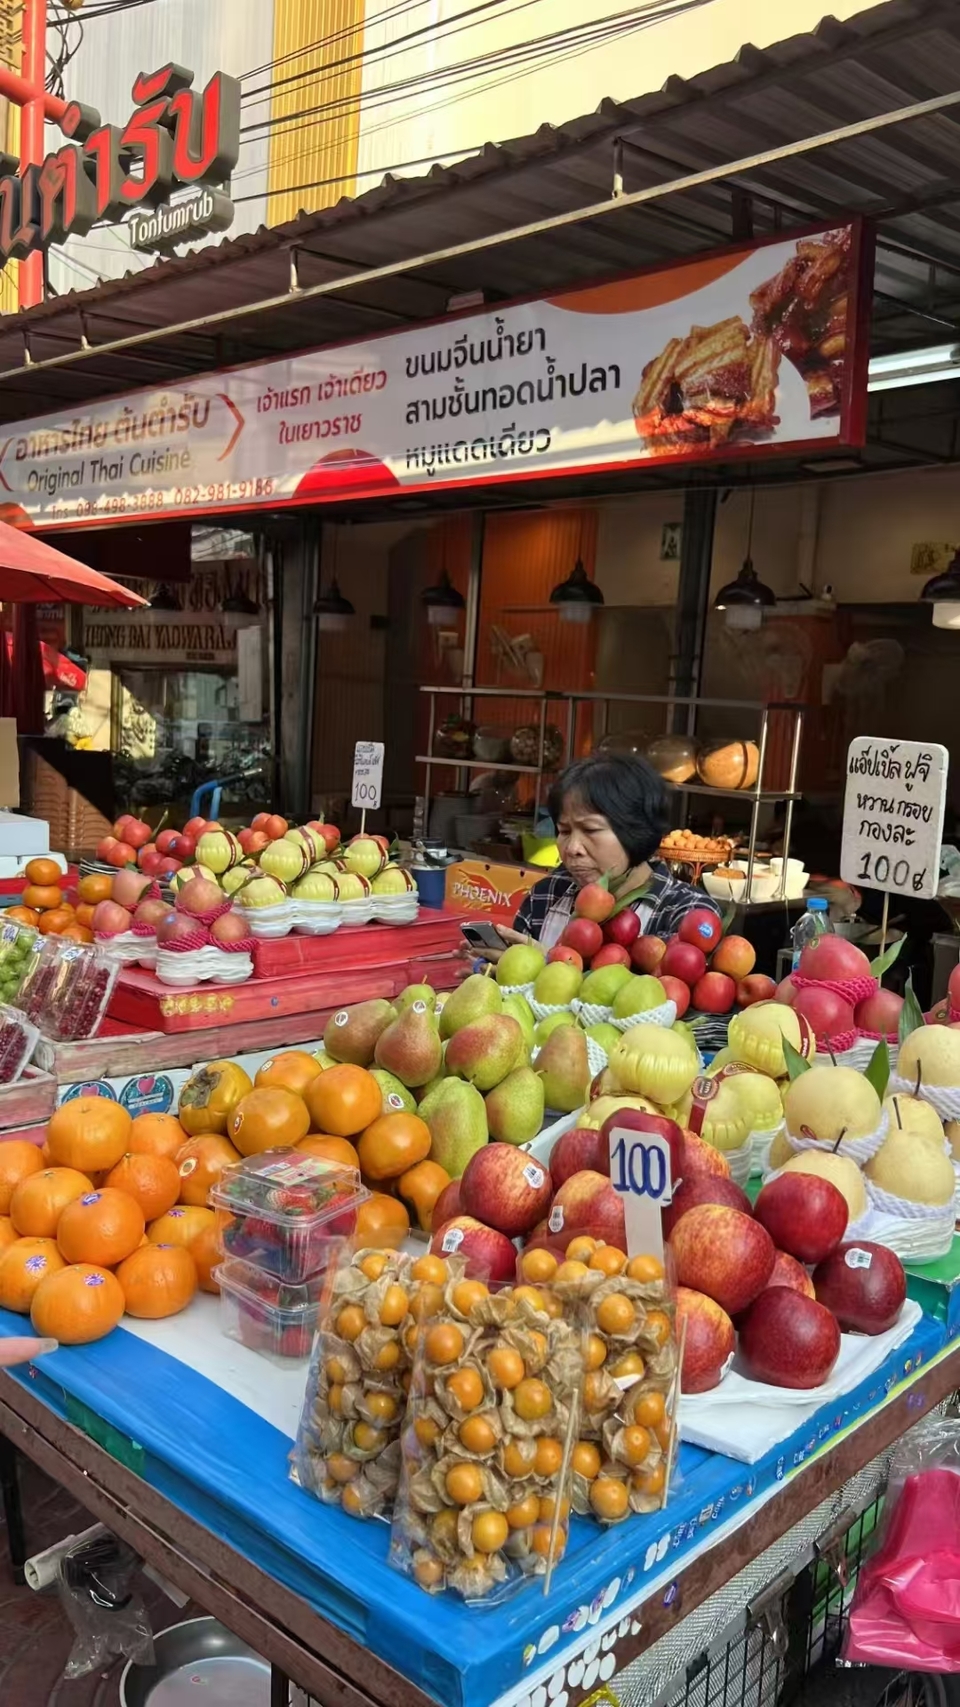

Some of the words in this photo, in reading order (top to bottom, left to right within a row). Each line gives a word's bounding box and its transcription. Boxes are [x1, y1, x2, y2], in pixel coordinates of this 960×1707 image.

[130, 191, 214, 244] Tontumrub
[405, 317, 547, 379] ขนมจีนน้ำยา
[257, 387, 311, 413] เจ้าแรก
[318, 366, 388, 401] เจ้าเดียว
[405, 356, 622, 424] สามชั้นทอดน้ำปลา
[15, 419, 109, 461] อาหารไทย
[114, 393, 210, 443] ต้นตำรับ
[279, 413, 362, 444] ในเยาวราช
[406, 422, 552, 477] หมูแดดเดียว
[27, 461, 85, 495] Original
[90, 456, 124, 483] Thai
[129, 447, 191, 476] Cuisine
[354, 782, 377, 801] 100
[857, 793, 895, 814] หวาน
[859, 820, 916, 846] กองละ
[453, 881, 512, 908] PHOENIX
